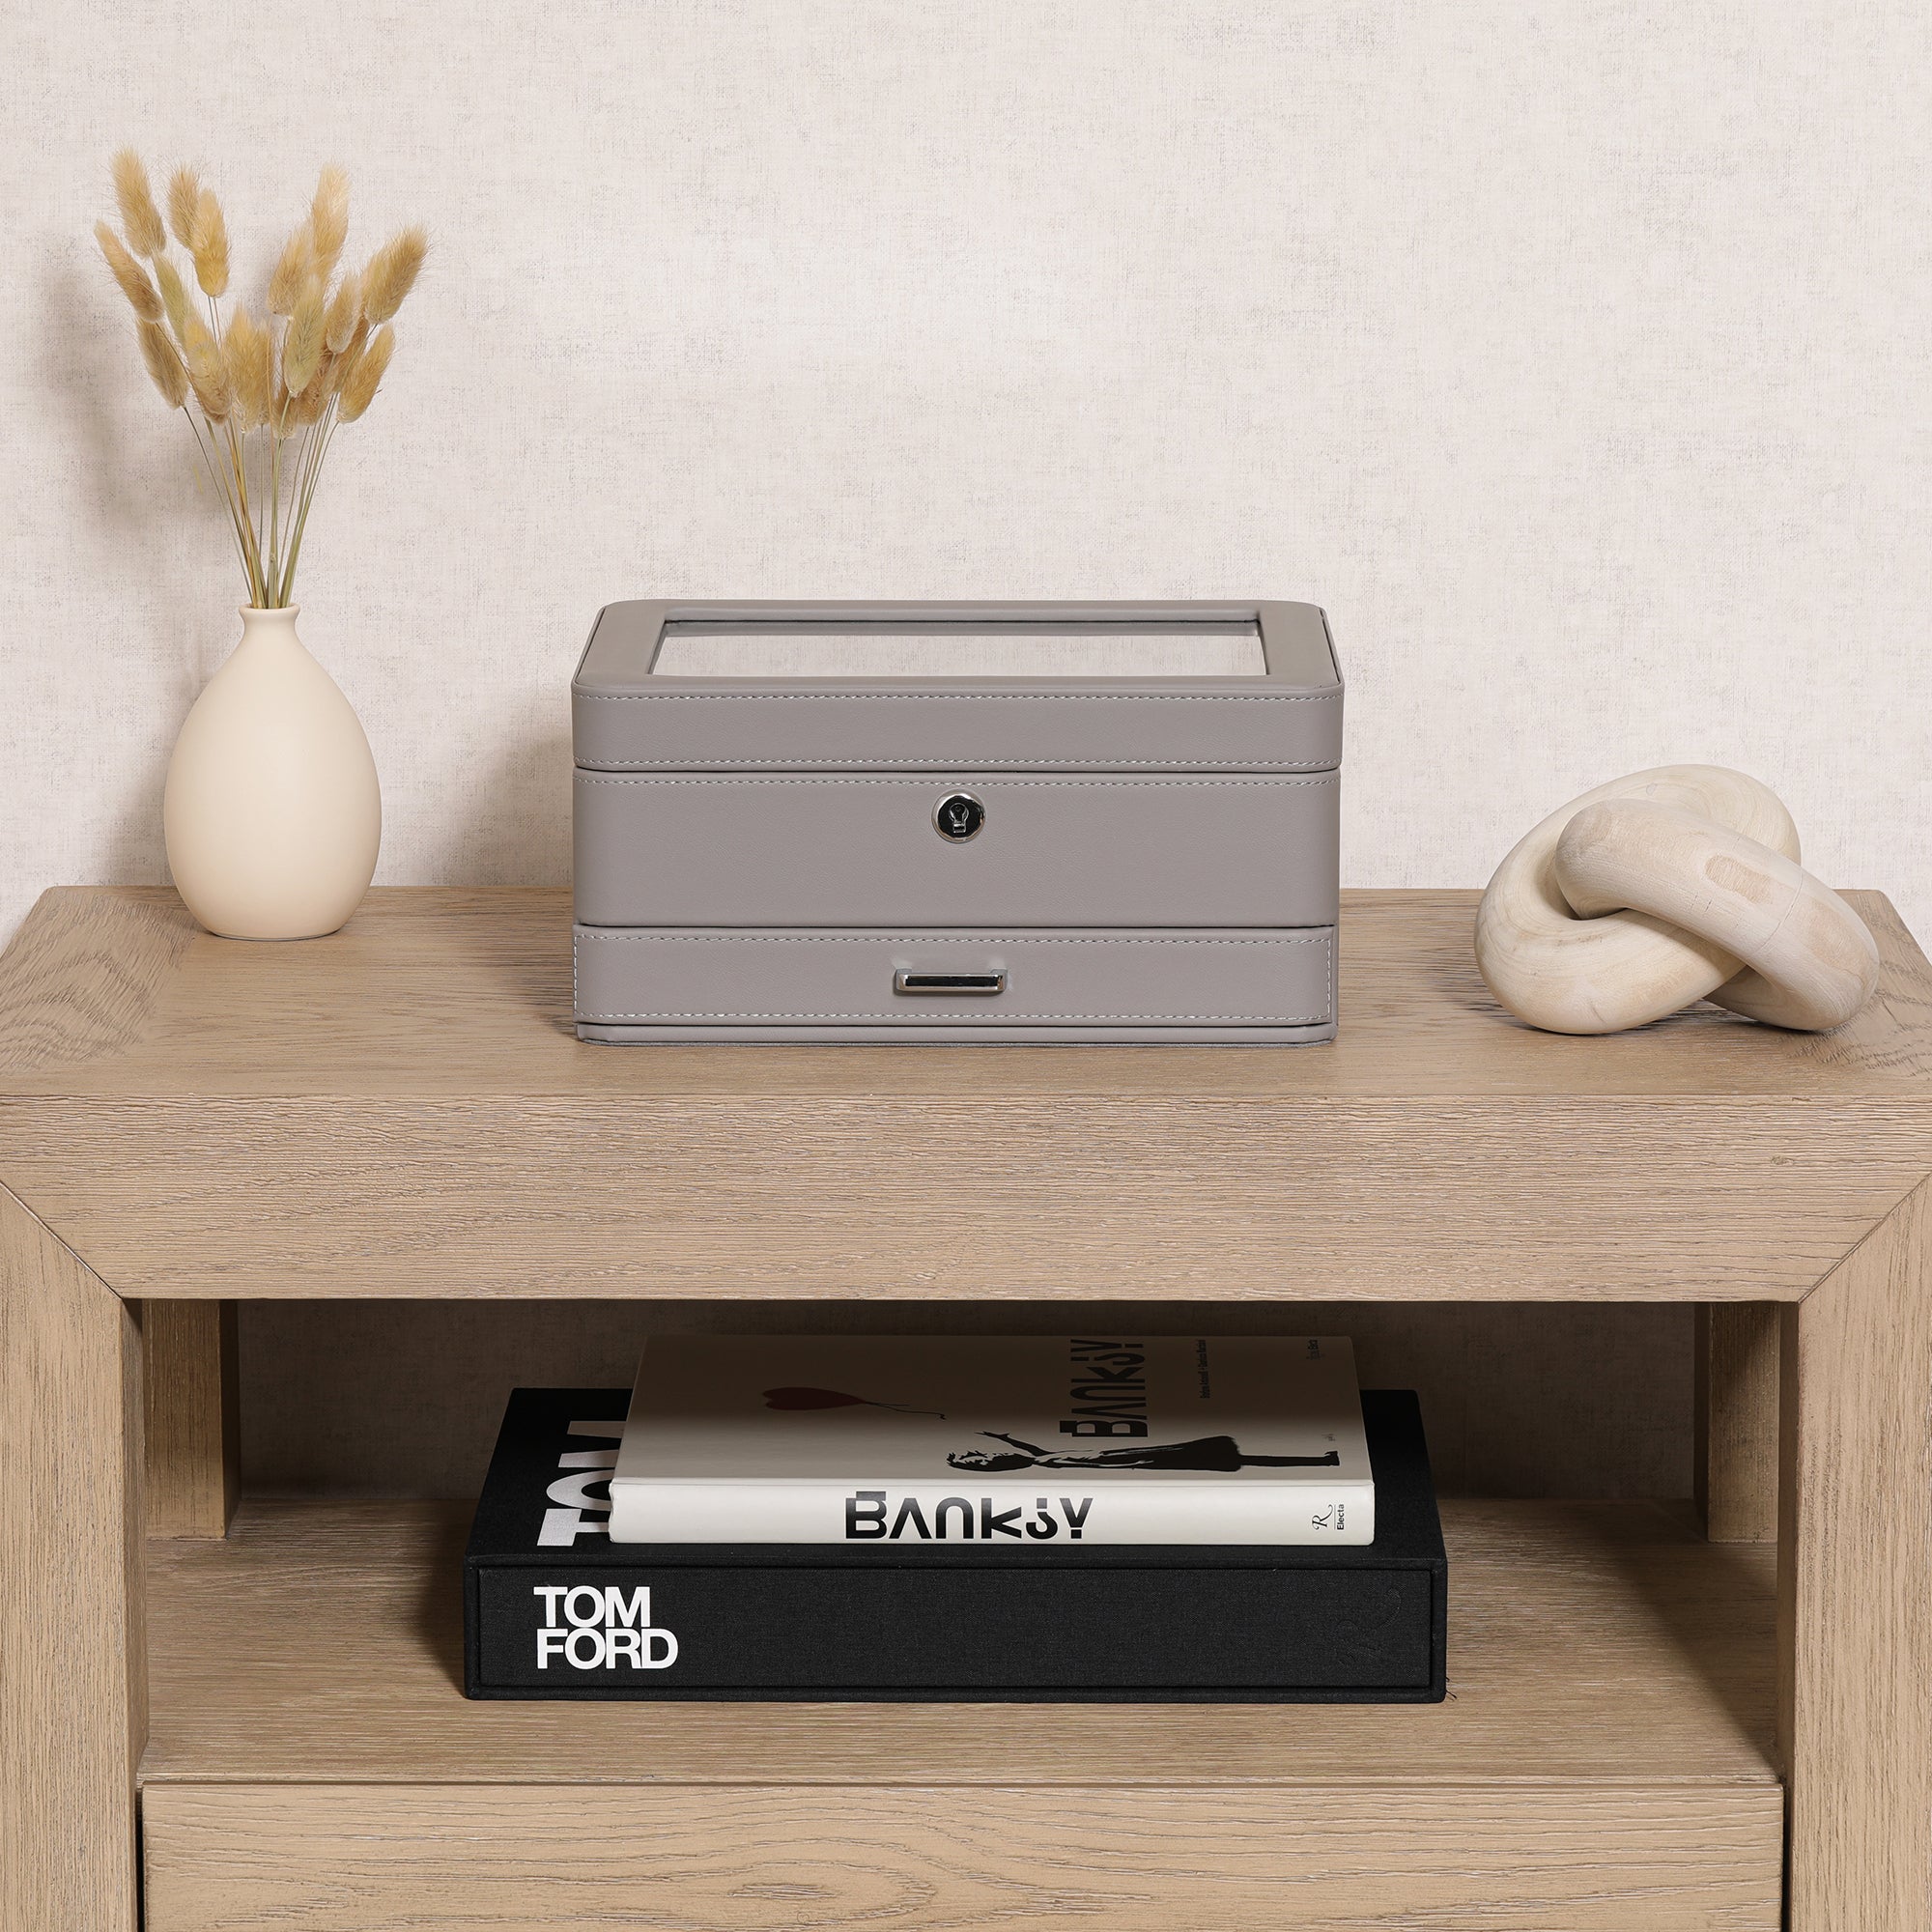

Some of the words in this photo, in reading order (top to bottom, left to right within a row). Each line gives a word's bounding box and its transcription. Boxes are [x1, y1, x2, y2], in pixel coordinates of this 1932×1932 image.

[1060, 1339, 1149, 1437] BANKSY
[845, 1492, 1094, 1540] BANKSY
[1336, 1503, 1345, 1531] Electa
[533, 1586, 651, 1628] TOM
[536, 1628, 679, 1670] FORD
